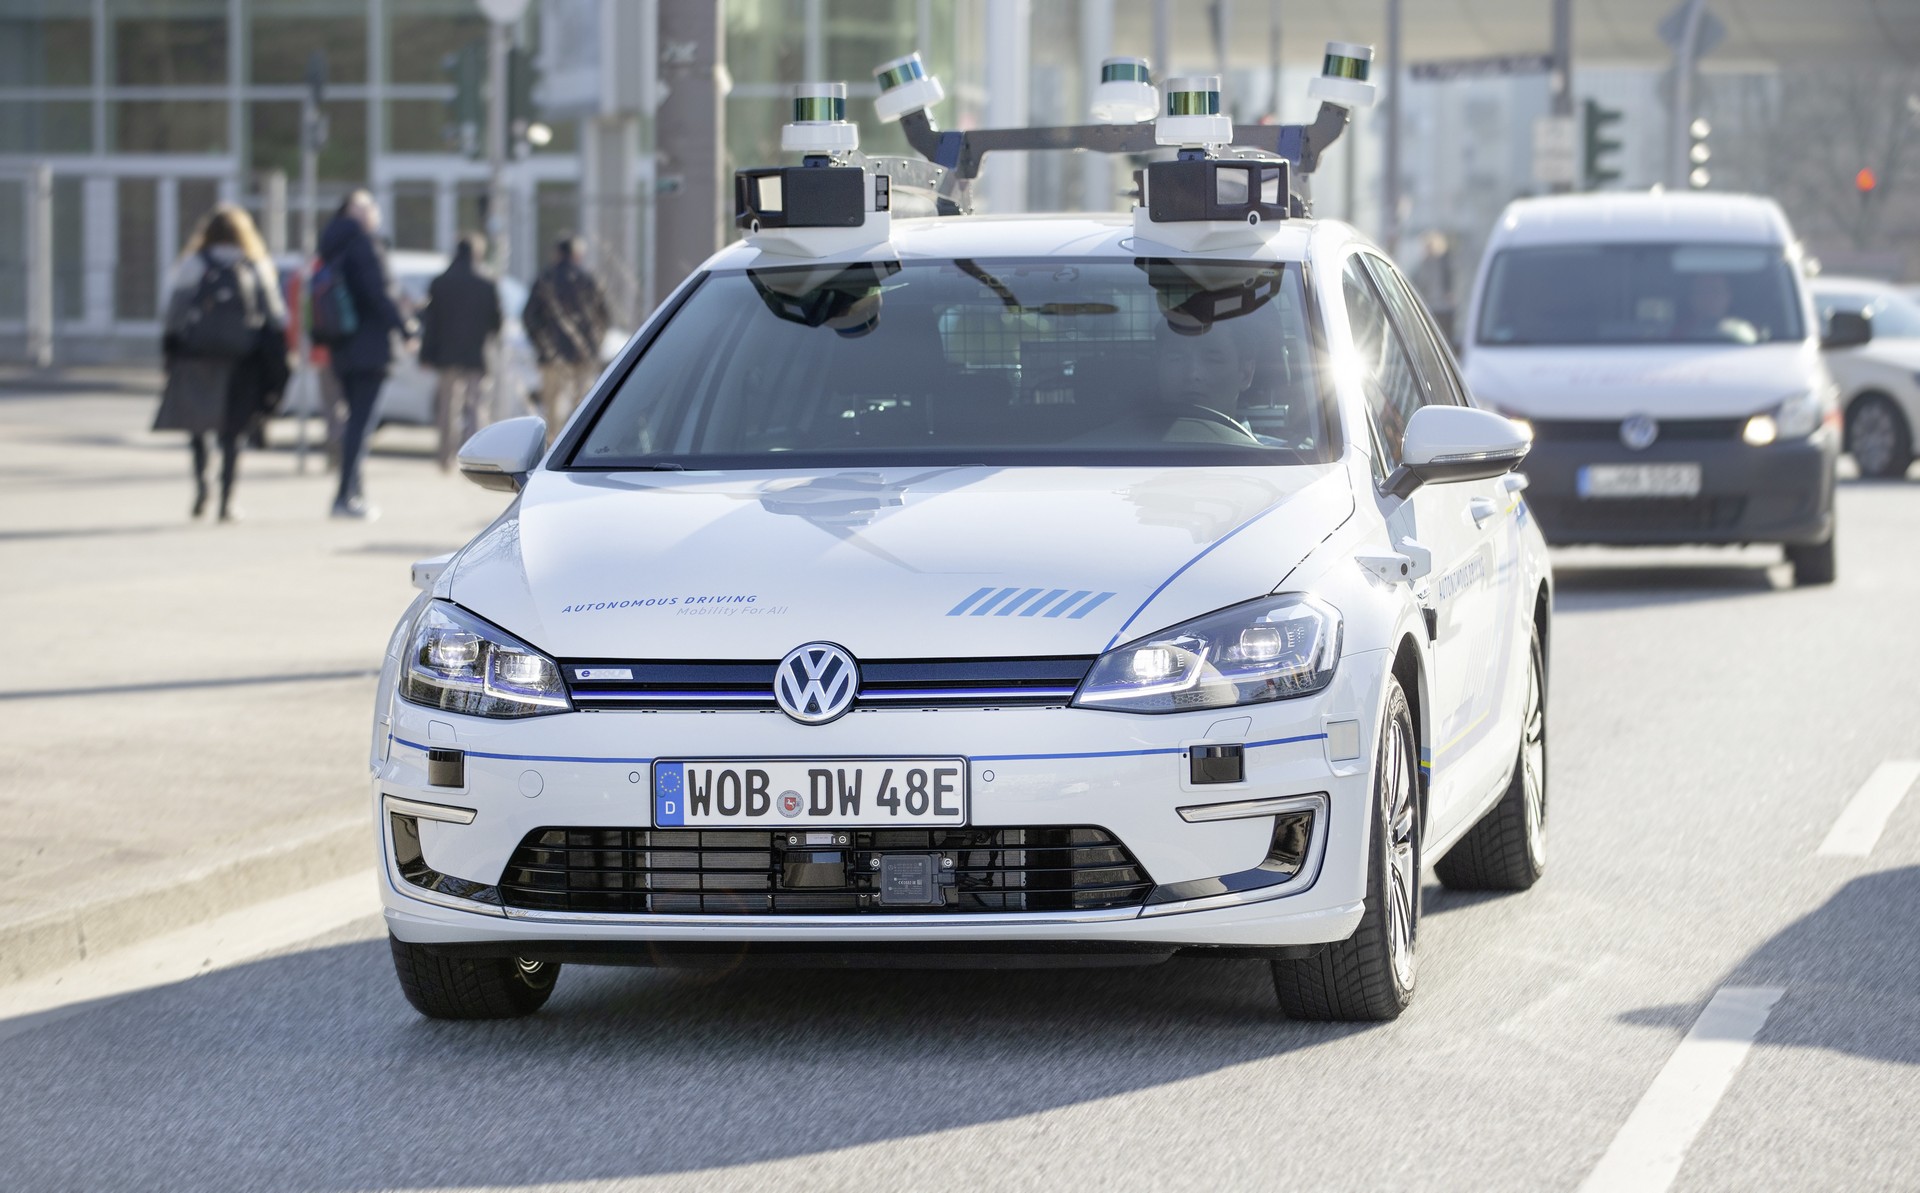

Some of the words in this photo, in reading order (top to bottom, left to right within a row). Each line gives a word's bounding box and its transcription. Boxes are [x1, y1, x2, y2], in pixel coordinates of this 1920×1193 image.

[561, 597, 679, 614] AUTONOMOUS
[684, 595, 758, 605] DRIVING
[676, 606, 738, 617] Mobility
[741, 606, 766, 614] For
[766, 606, 789, 615] All
[774, 643, 858, 722] VW
[687, 769, 770, 816] WOB
[808, 768, 862, 816] DW
[876, 768, 960, 816] 48E
[665, 801, 676, 814] D
